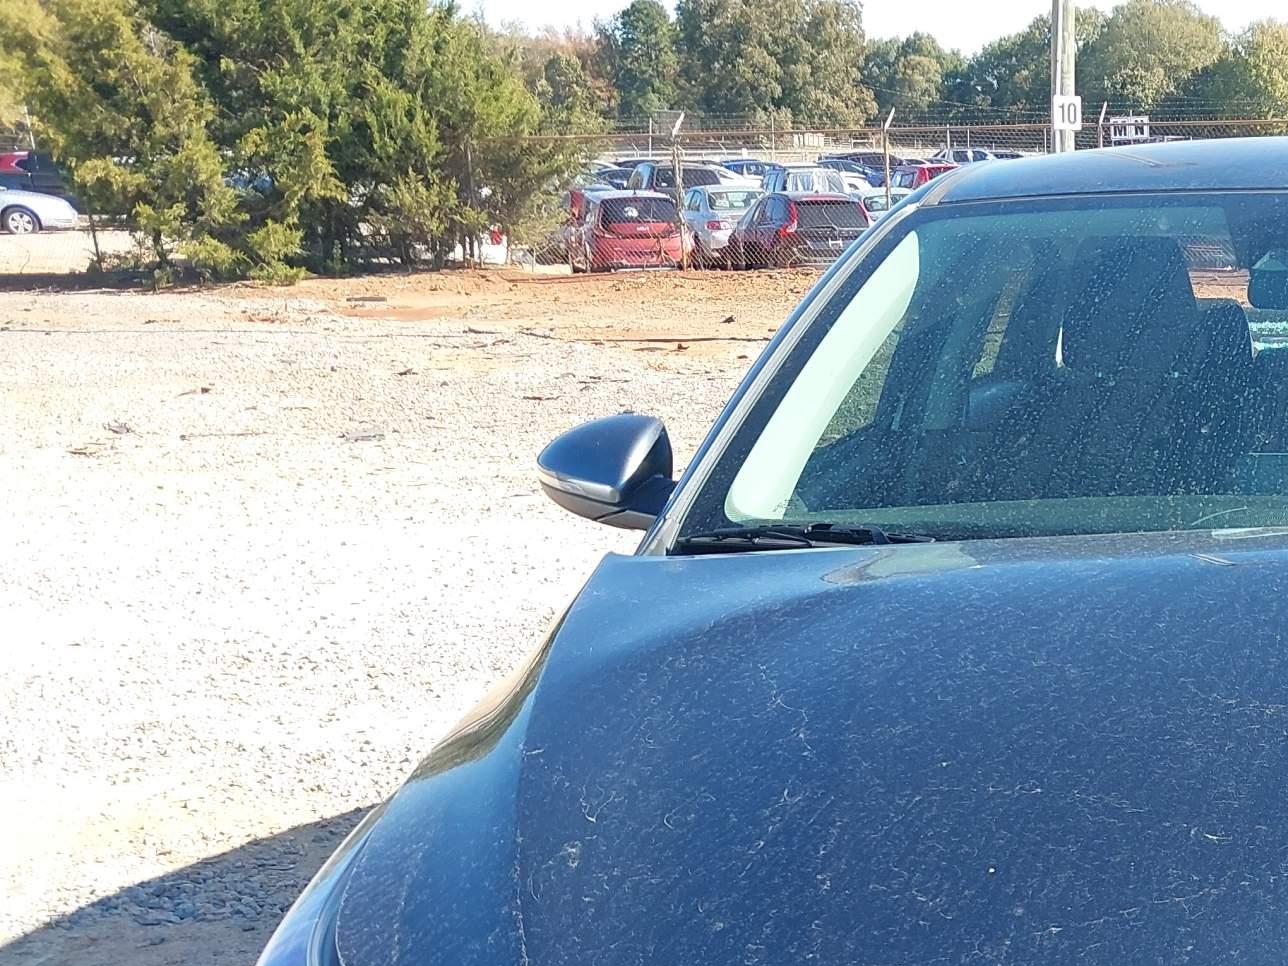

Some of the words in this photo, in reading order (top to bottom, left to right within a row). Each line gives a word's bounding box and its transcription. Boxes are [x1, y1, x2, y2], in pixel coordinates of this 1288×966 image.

[1058, 102, 1077, 125] 10
[1113, 119, 1128, 137] M
[1134, 119, 1145, 136] N
